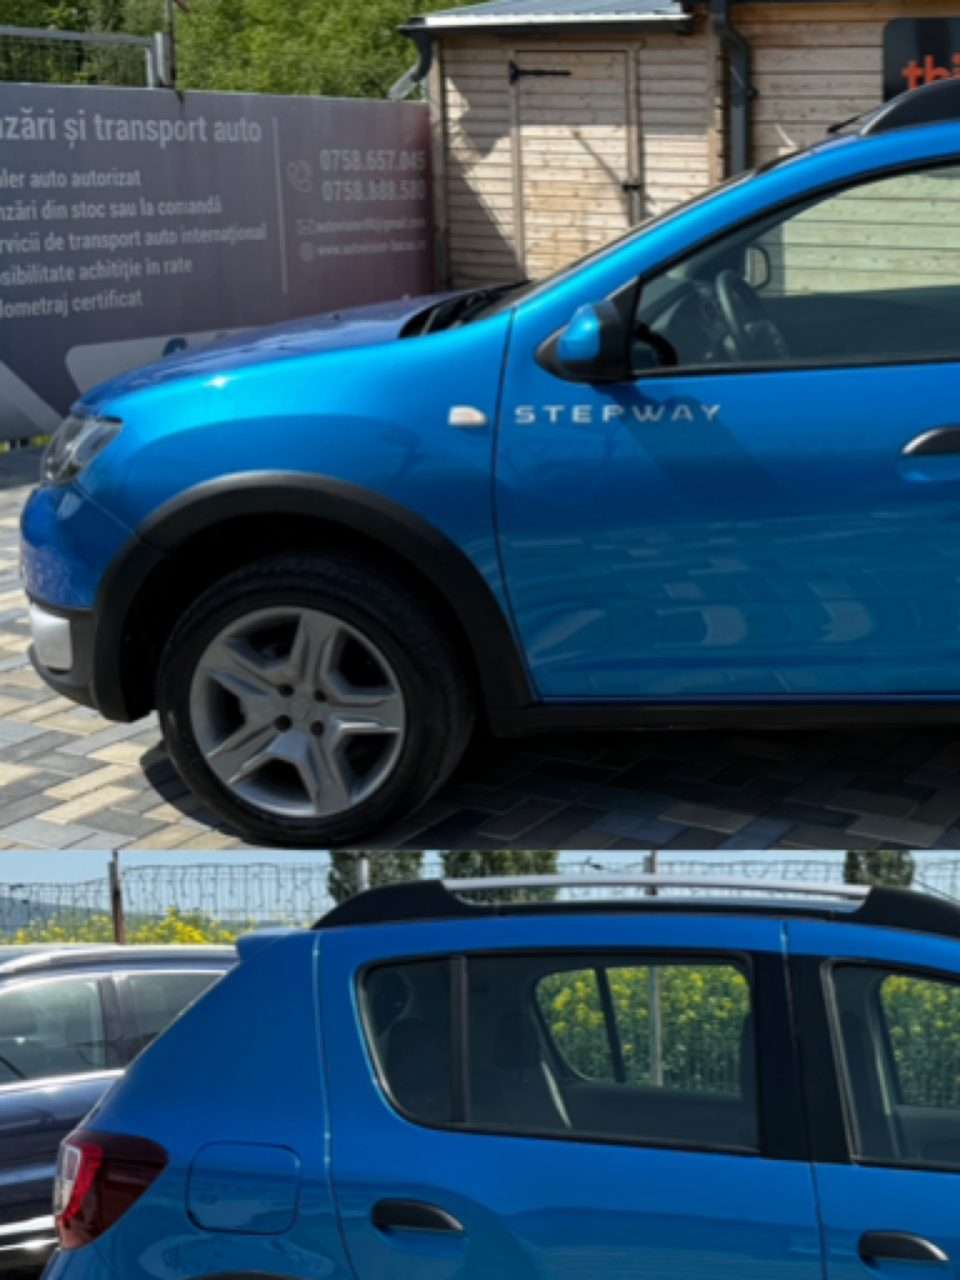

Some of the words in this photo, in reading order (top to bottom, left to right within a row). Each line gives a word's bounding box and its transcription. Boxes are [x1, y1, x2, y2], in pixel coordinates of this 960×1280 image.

[0, 106, 56, 140] zări
[63, 108, 88, 149] și
[93, 113, 209, 149] transport
[213, 116, 263, 143] auto
[29, 169, 69, 188] auto
[71, 199, 105, 219] stoc
[108, 202, 138, 218] sau
[43, 230, 66, 252] de
[68, 229, 142, 253] transport
[144, 229, 178, 247] auto
[514, 404, 721, 424] STEPWAY
